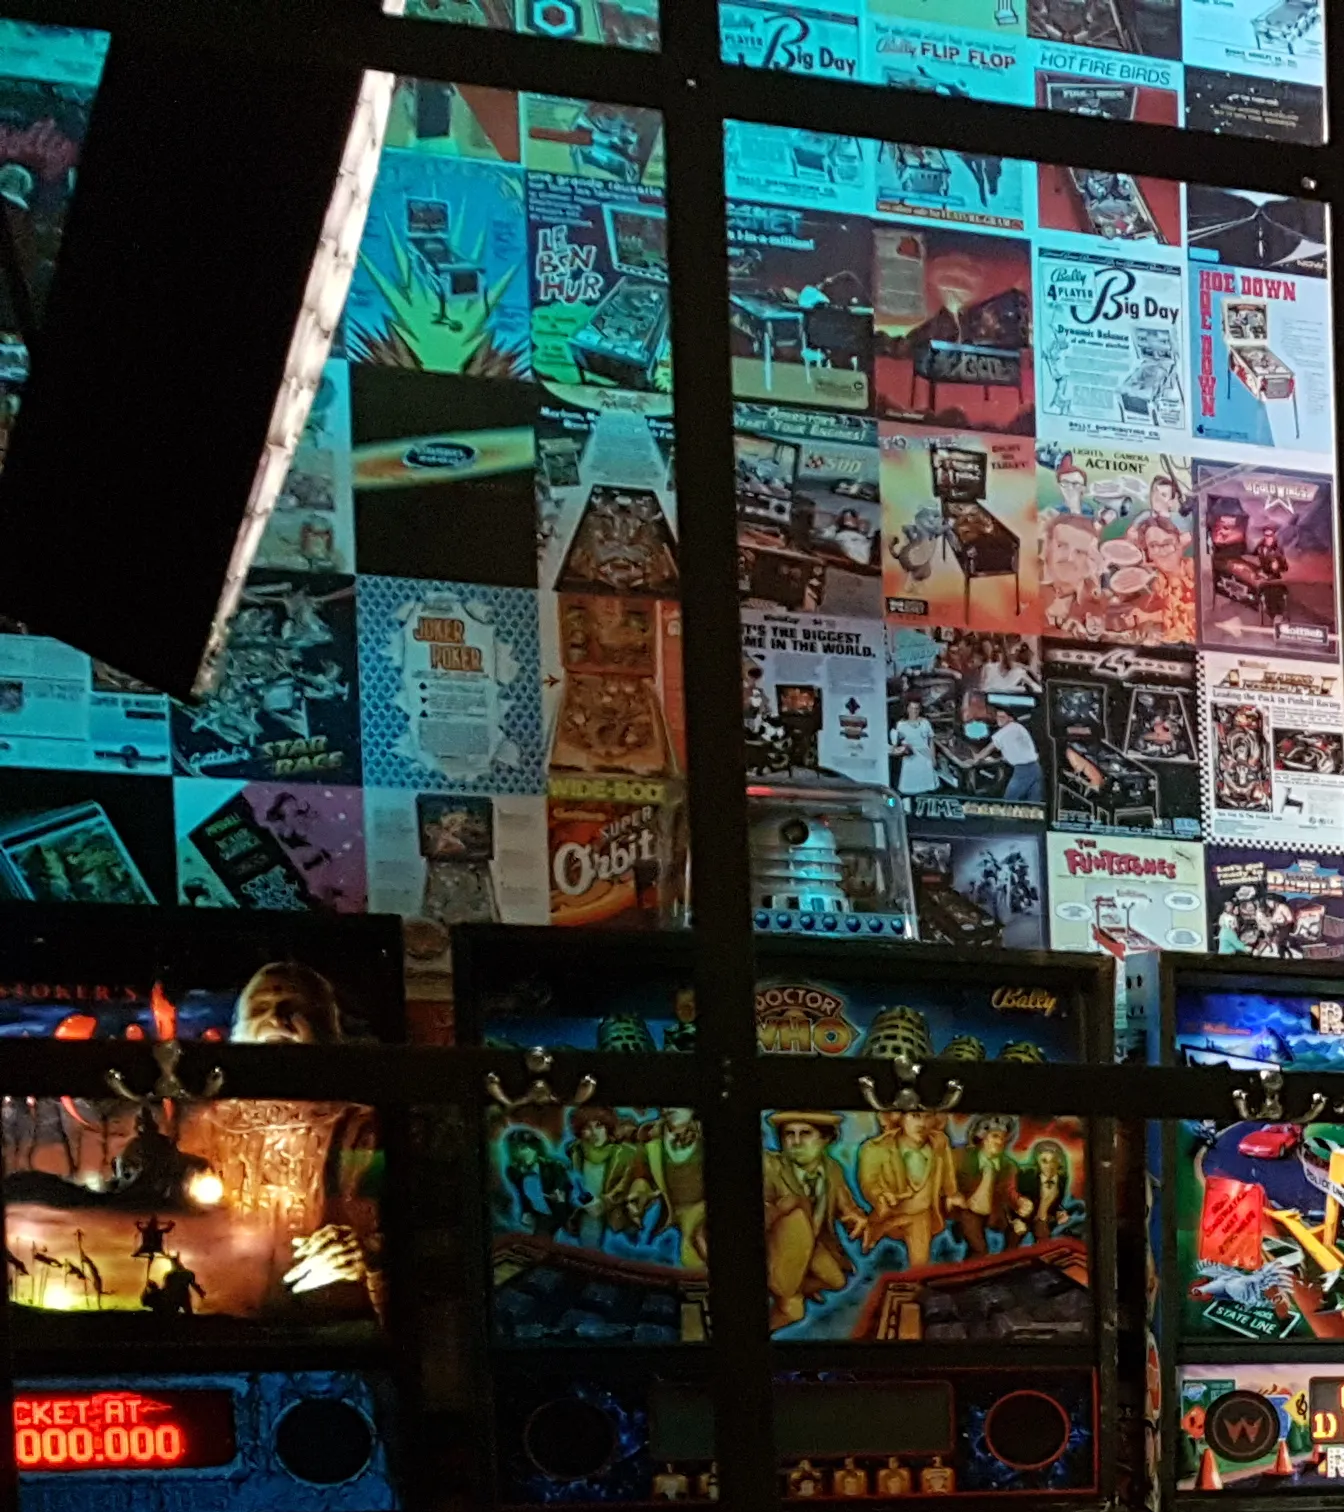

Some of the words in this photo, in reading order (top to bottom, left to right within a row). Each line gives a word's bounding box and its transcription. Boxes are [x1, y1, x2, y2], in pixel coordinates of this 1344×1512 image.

[764, 14, 815, 69] Big
[819, 47, 856, 76] Day
[920, 42, 960, 61] FLIP
[966, 47, 1016, 69] FLOP
[1040, 52, 1075, 70] HOT
[1079, 58, 1116, 76] FIRE
[1119, 64, 1171, 86] BIRDS
[539, 271, 603, 305] HUR
[1050, 267, 1088, 284] Bally
[1199, 270, 1236, 294] HOE
[1240, 275, 1297, 302] DOWN
[1046, 284, 1058, 302] 4
[1058, 287, 1094, 300] PLAYER
[1144, 296, 1180, 325] Day
[413, 615, 465, 644] JOKER
[801, 630, 862, 644] BIGGEST
[429, 644, 484, 672] POKER
[770, 638, 786, 650] IN
[791, 639, 817, 652] THE
[821, 641, 877, 658] WORLD.
[600, 804, 653, 840] SUPER
[915, 799, 965, 820] TIME
[1075, 838, 1097, 850] THE
[553, 829, 656, 896] Orbit
[755, 985, 838, 1015] DOCTOR
[991, 986, 1057, 1015] Bally
[757, 1010, 852, 1056] WHO
[1216, 1305, 1248, 1328] STATE
[1248, 1317, 1277, 1336] LINE
[104, 1400, 142, 1423] AT
[1313, 1412, 1336, 1438] 1)
